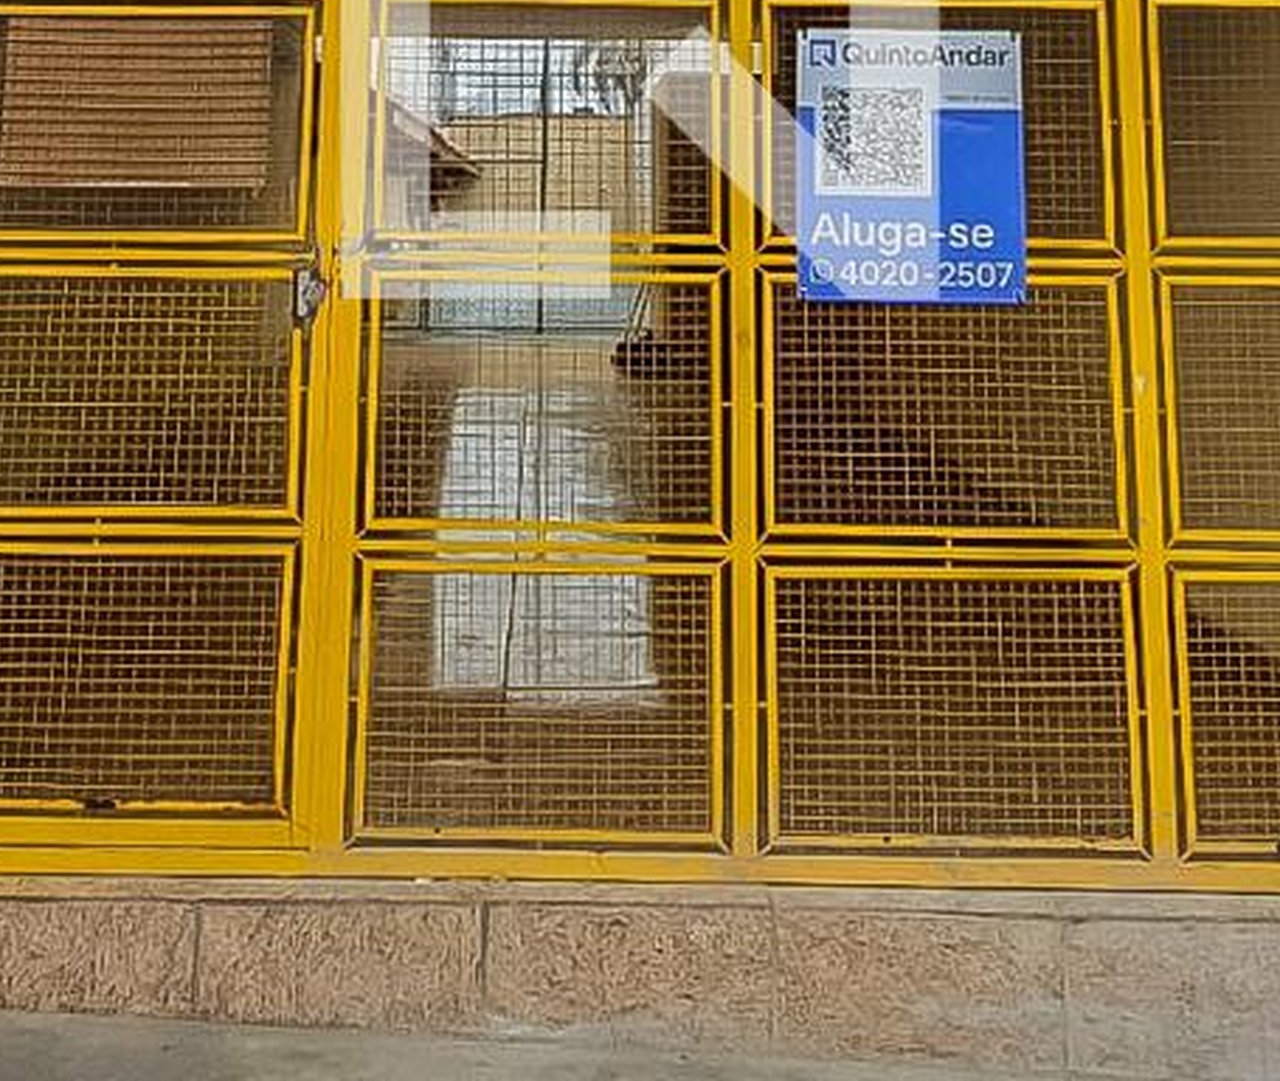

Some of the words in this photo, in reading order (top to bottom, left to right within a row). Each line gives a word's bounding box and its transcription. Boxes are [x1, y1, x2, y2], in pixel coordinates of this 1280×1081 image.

[841, 41, 1010, 68] QuintoAndar
[811, 211, 995, 257] Aluga-se
[840, 260, 1014, 290] 4020-2507
